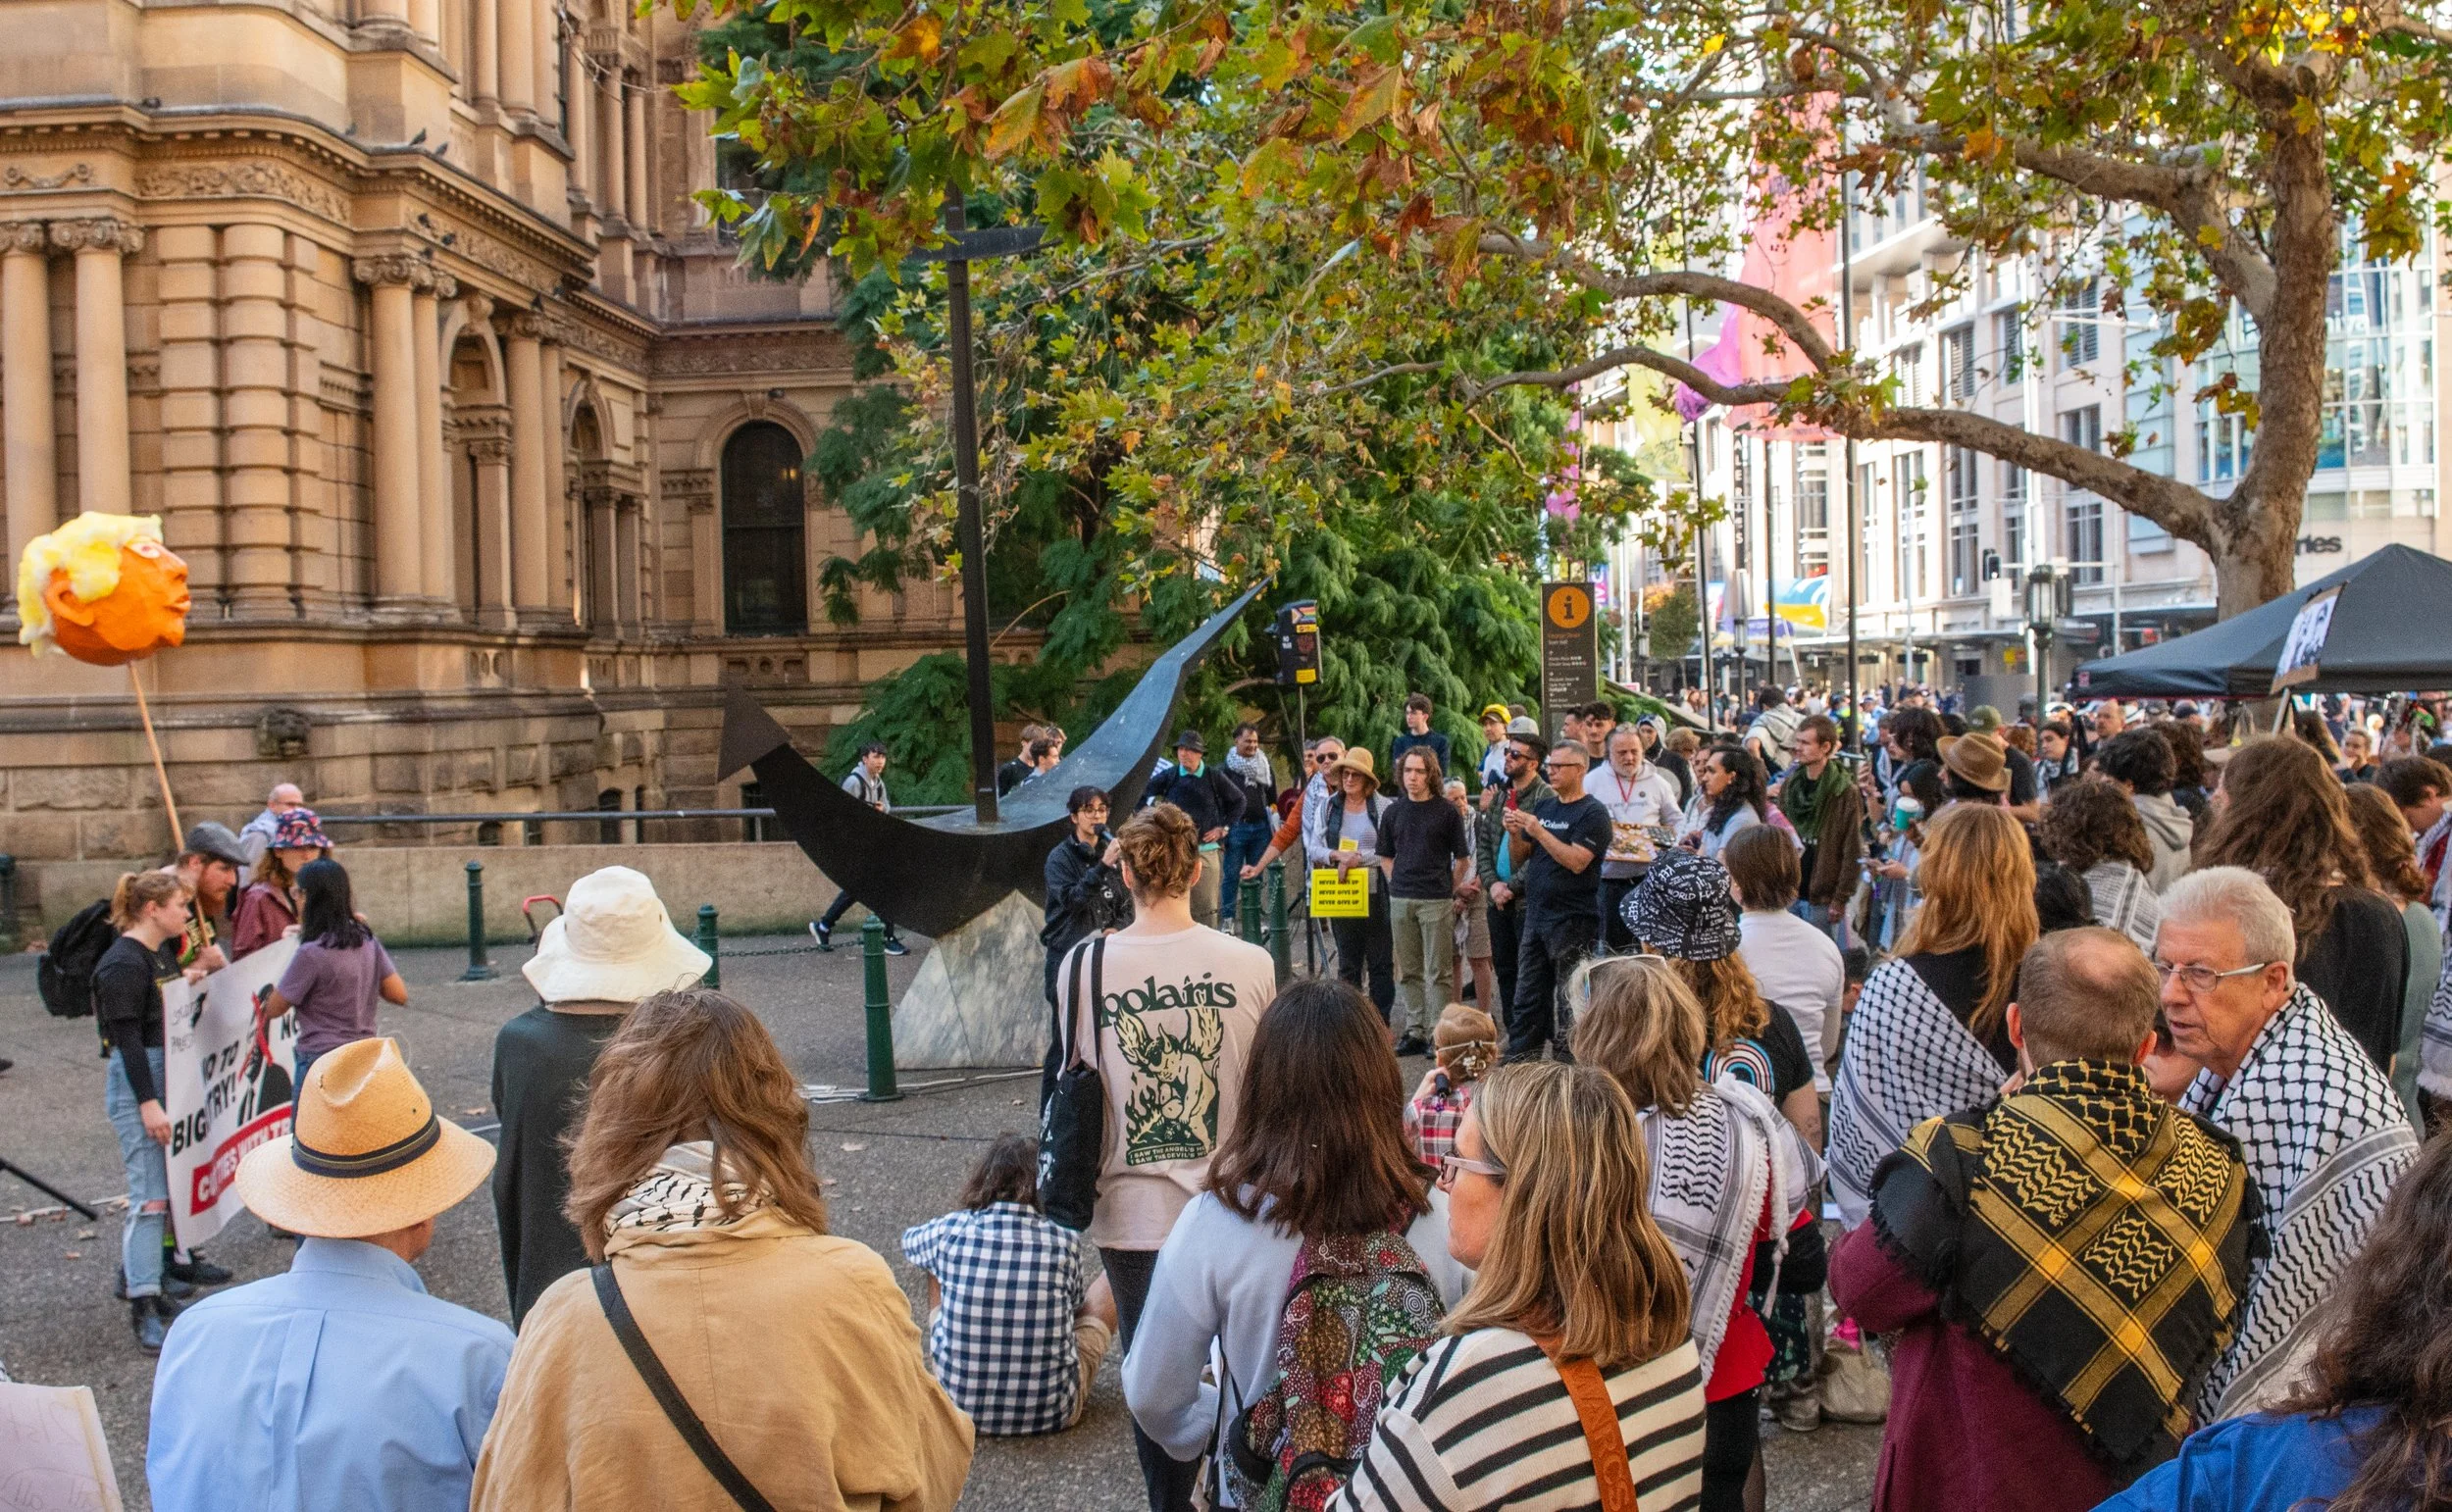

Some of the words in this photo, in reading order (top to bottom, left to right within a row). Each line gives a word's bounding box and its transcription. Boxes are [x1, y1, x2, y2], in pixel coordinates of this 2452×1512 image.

[2295, 534, 2342, 556] ries
[1099, 972, 1238, 1028] polaris
[1134, 1149, 1151, 1158] SAW
